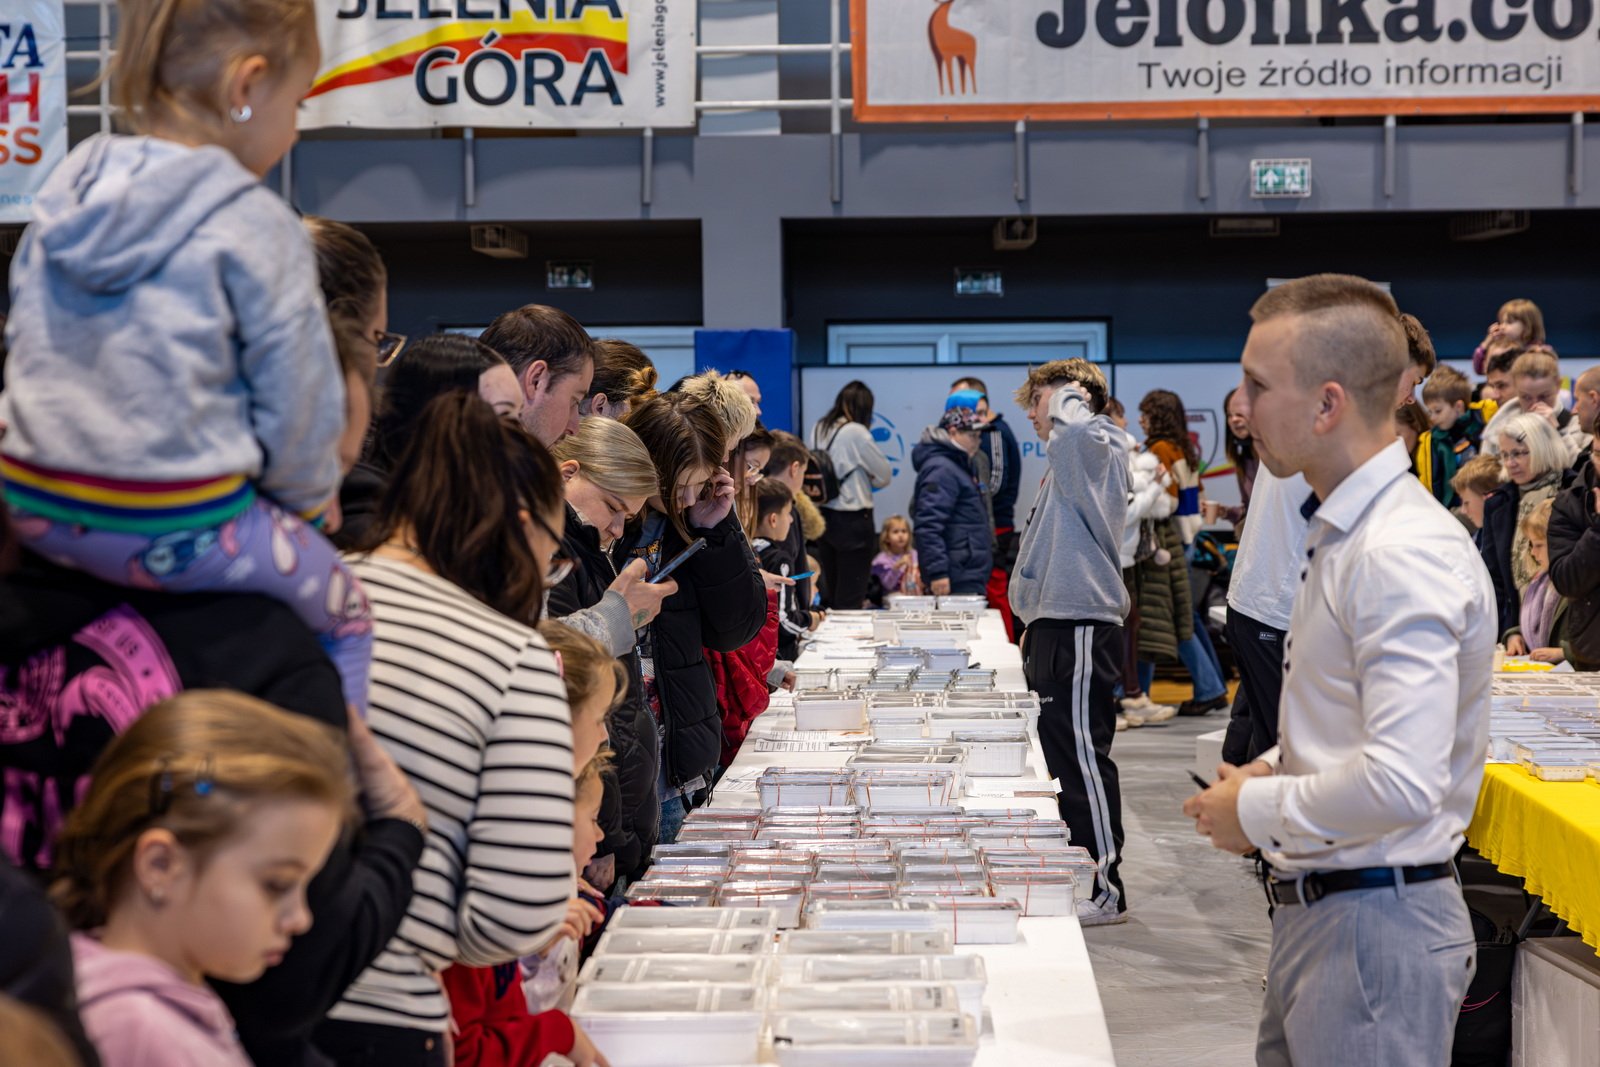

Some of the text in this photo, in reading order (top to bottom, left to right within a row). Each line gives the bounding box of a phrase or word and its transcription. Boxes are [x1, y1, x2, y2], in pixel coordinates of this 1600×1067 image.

[415, 30, 624, 107] GÓRA
[1138, 56, 1562, 94] Twoje źródło informacji
